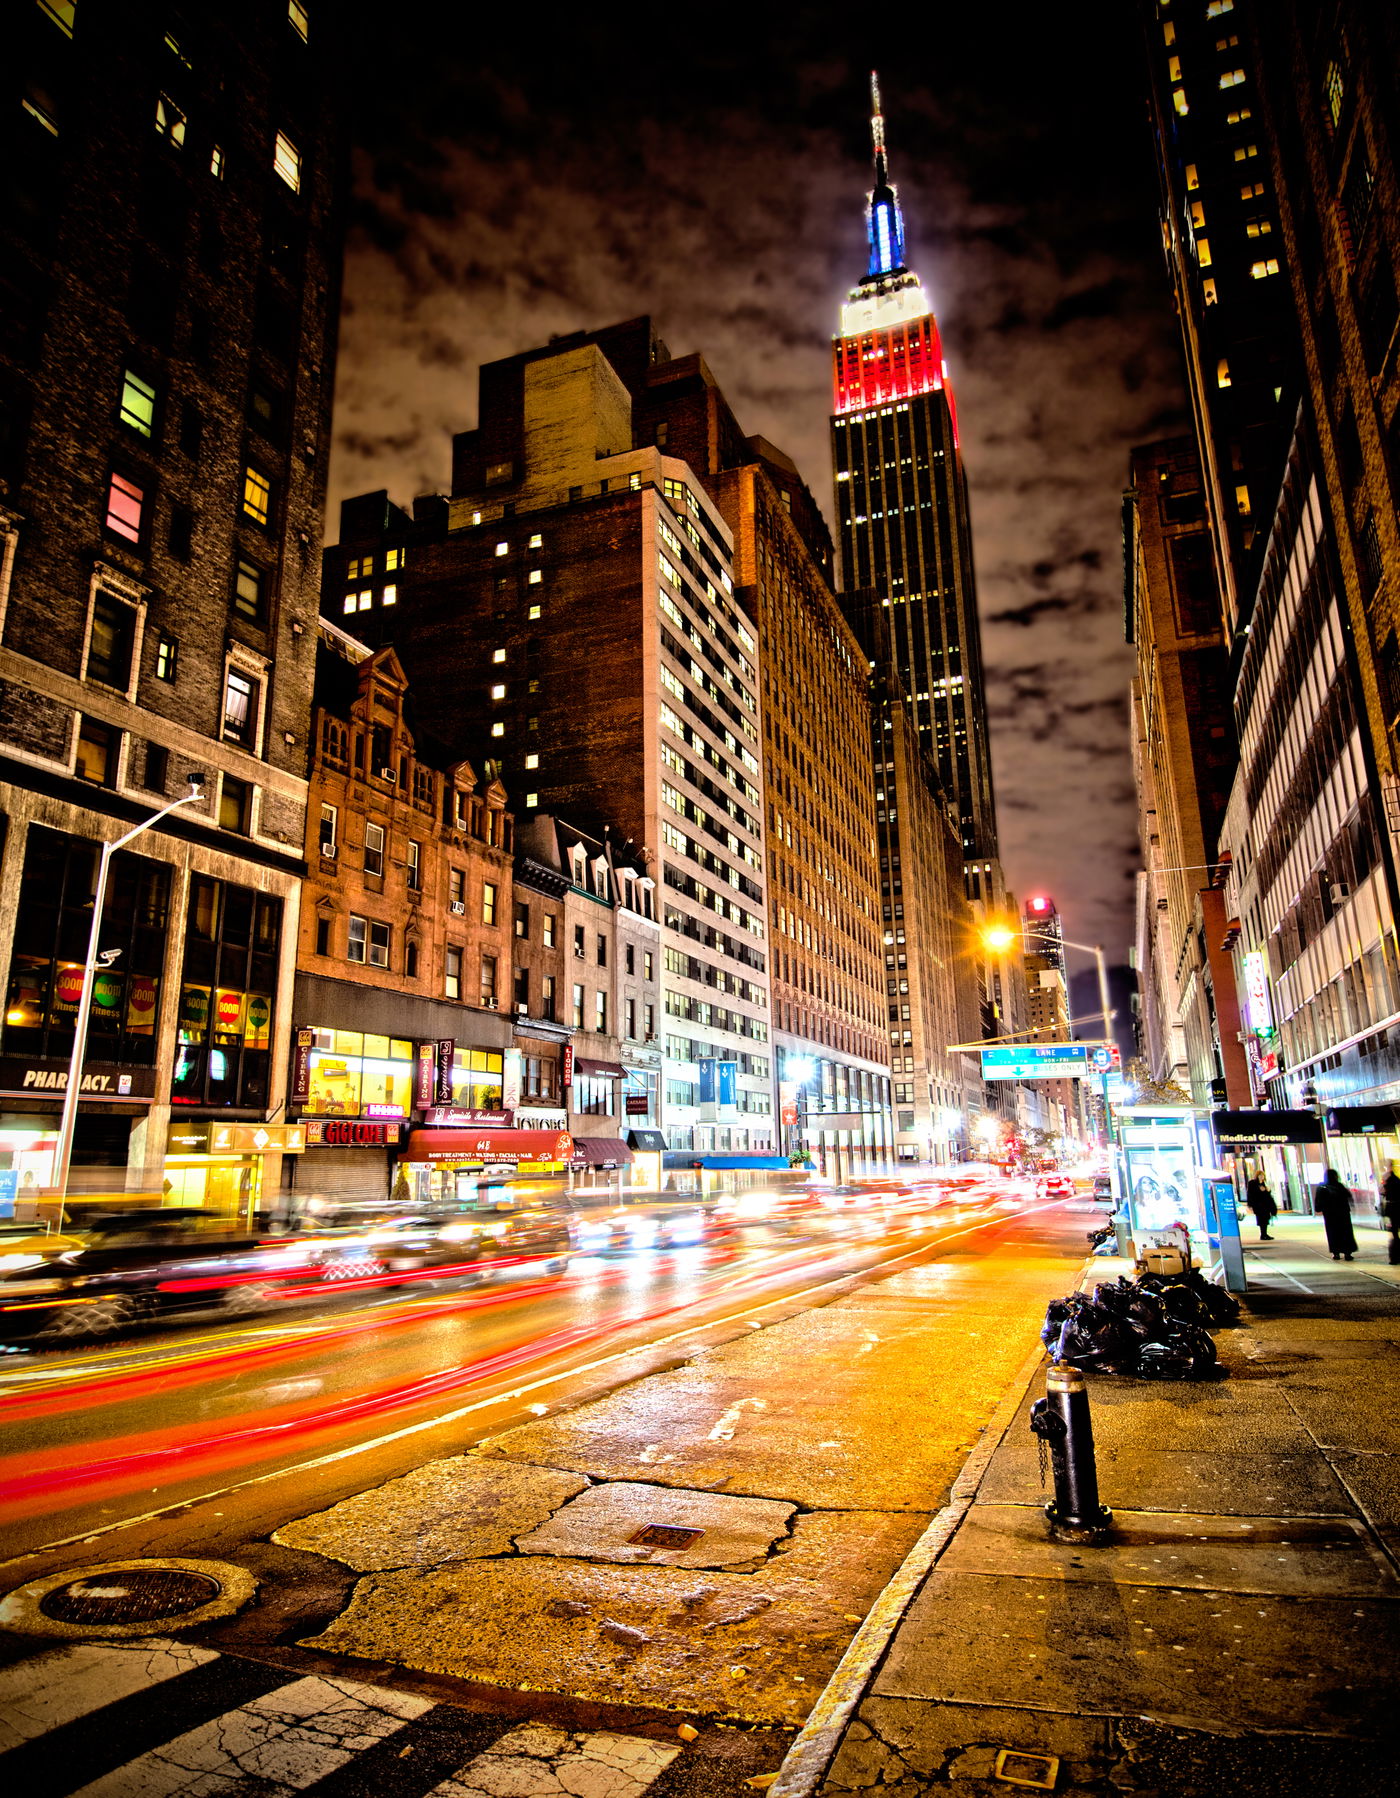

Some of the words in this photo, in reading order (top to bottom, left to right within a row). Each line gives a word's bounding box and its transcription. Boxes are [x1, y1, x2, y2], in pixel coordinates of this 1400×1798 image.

[92, 1006, 120, 1017] Fitness
[220, 1002, 239, 1014] BOOM
[1036, 1049, 1057, 1057] LANE
[297, 1046, 309, 1092] CATERING
[1061, 1063, 1081, 1071] ONLY
[22, 1070, 111, 1092] PHARACY
[421, 1059, 430, 1099] CATERING
[474, 1111, 507, 1121] Restaurant
[1220, 1134, 1257, 1142] Medical
[1258, 1134, 1288, 1143] Group
